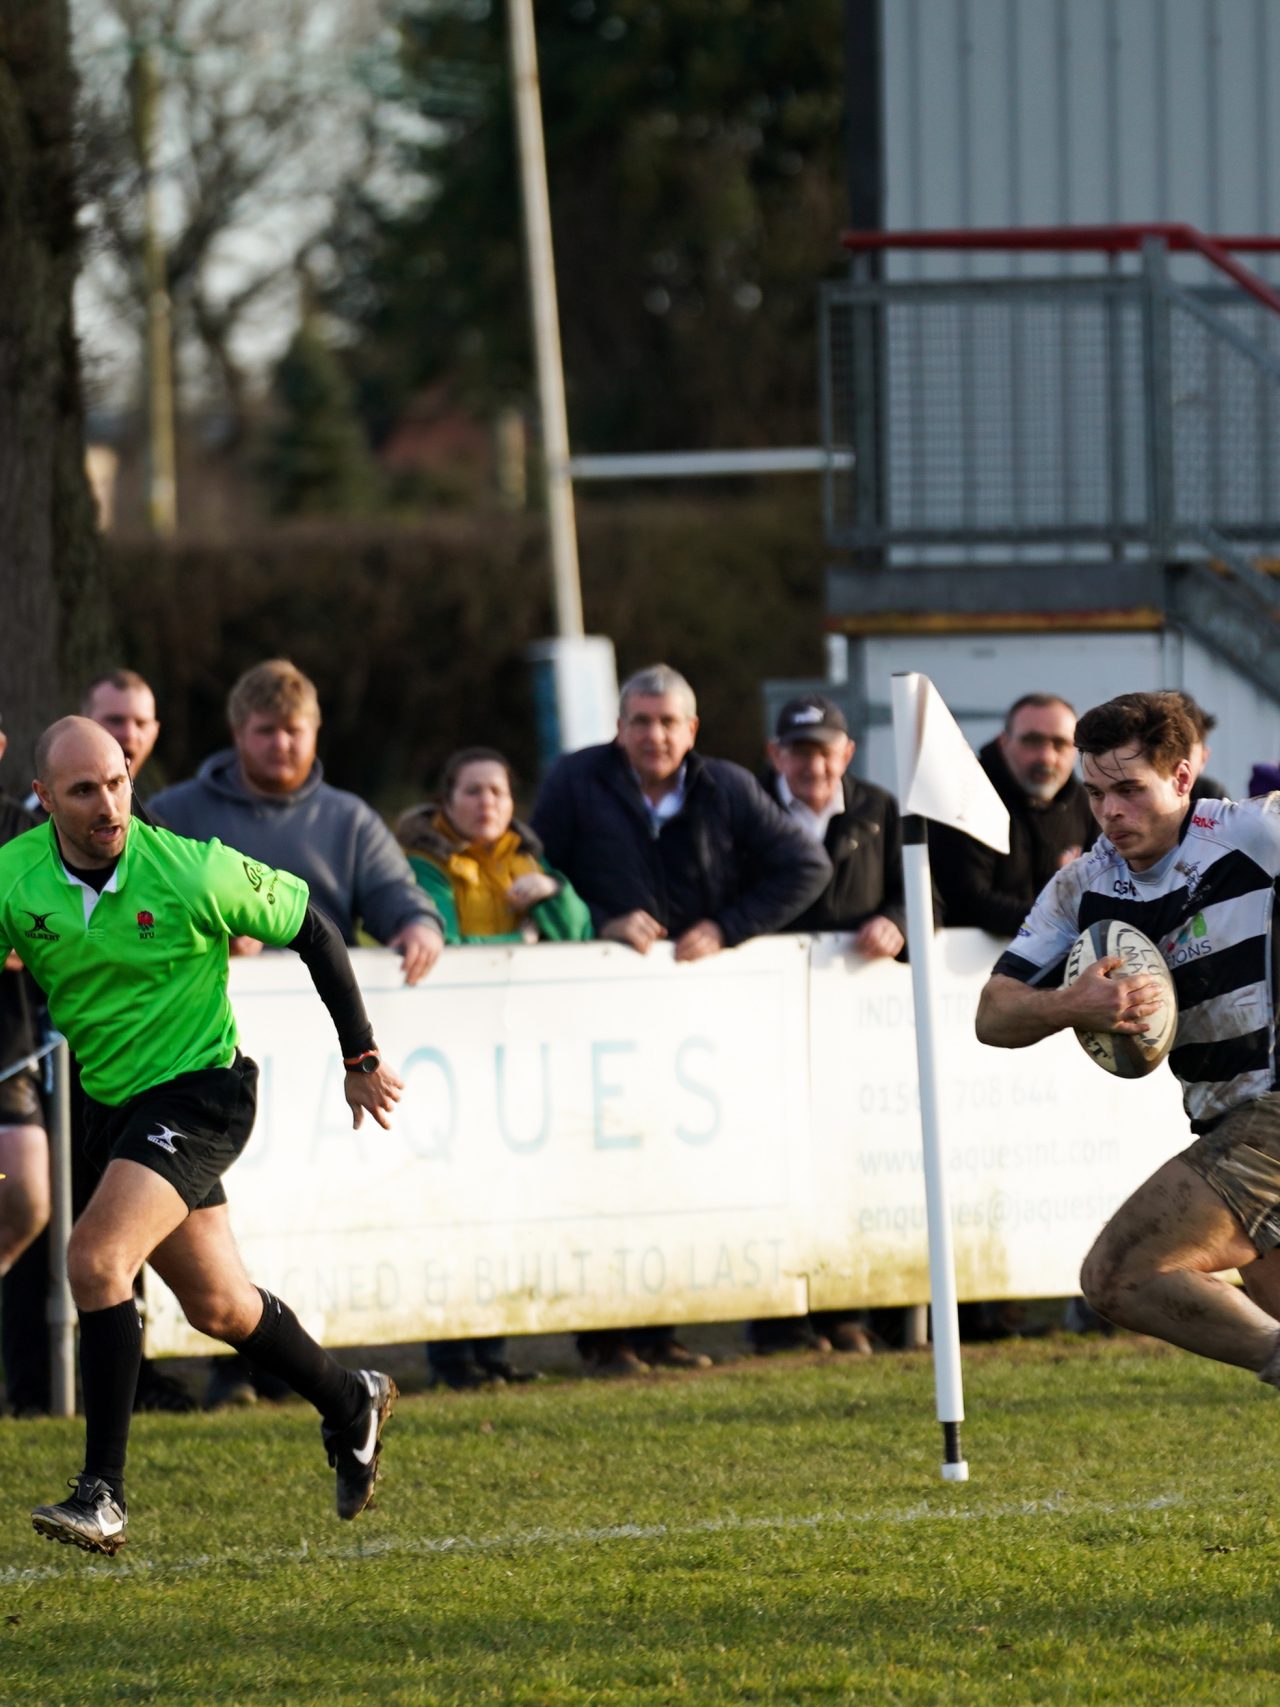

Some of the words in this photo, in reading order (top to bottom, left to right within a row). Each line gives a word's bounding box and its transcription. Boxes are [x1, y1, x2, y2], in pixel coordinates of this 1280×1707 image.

[1068, 939, 1112, 1059] GILRT
[238, 1034, 723, 1168] JAQUES
[424, 1257, 450, 1307] &
[474, 1250, 591, 1307] BUILT
[615, 1244, 667, 1297] TO
[688, 1238, 788, 1291] LAST
